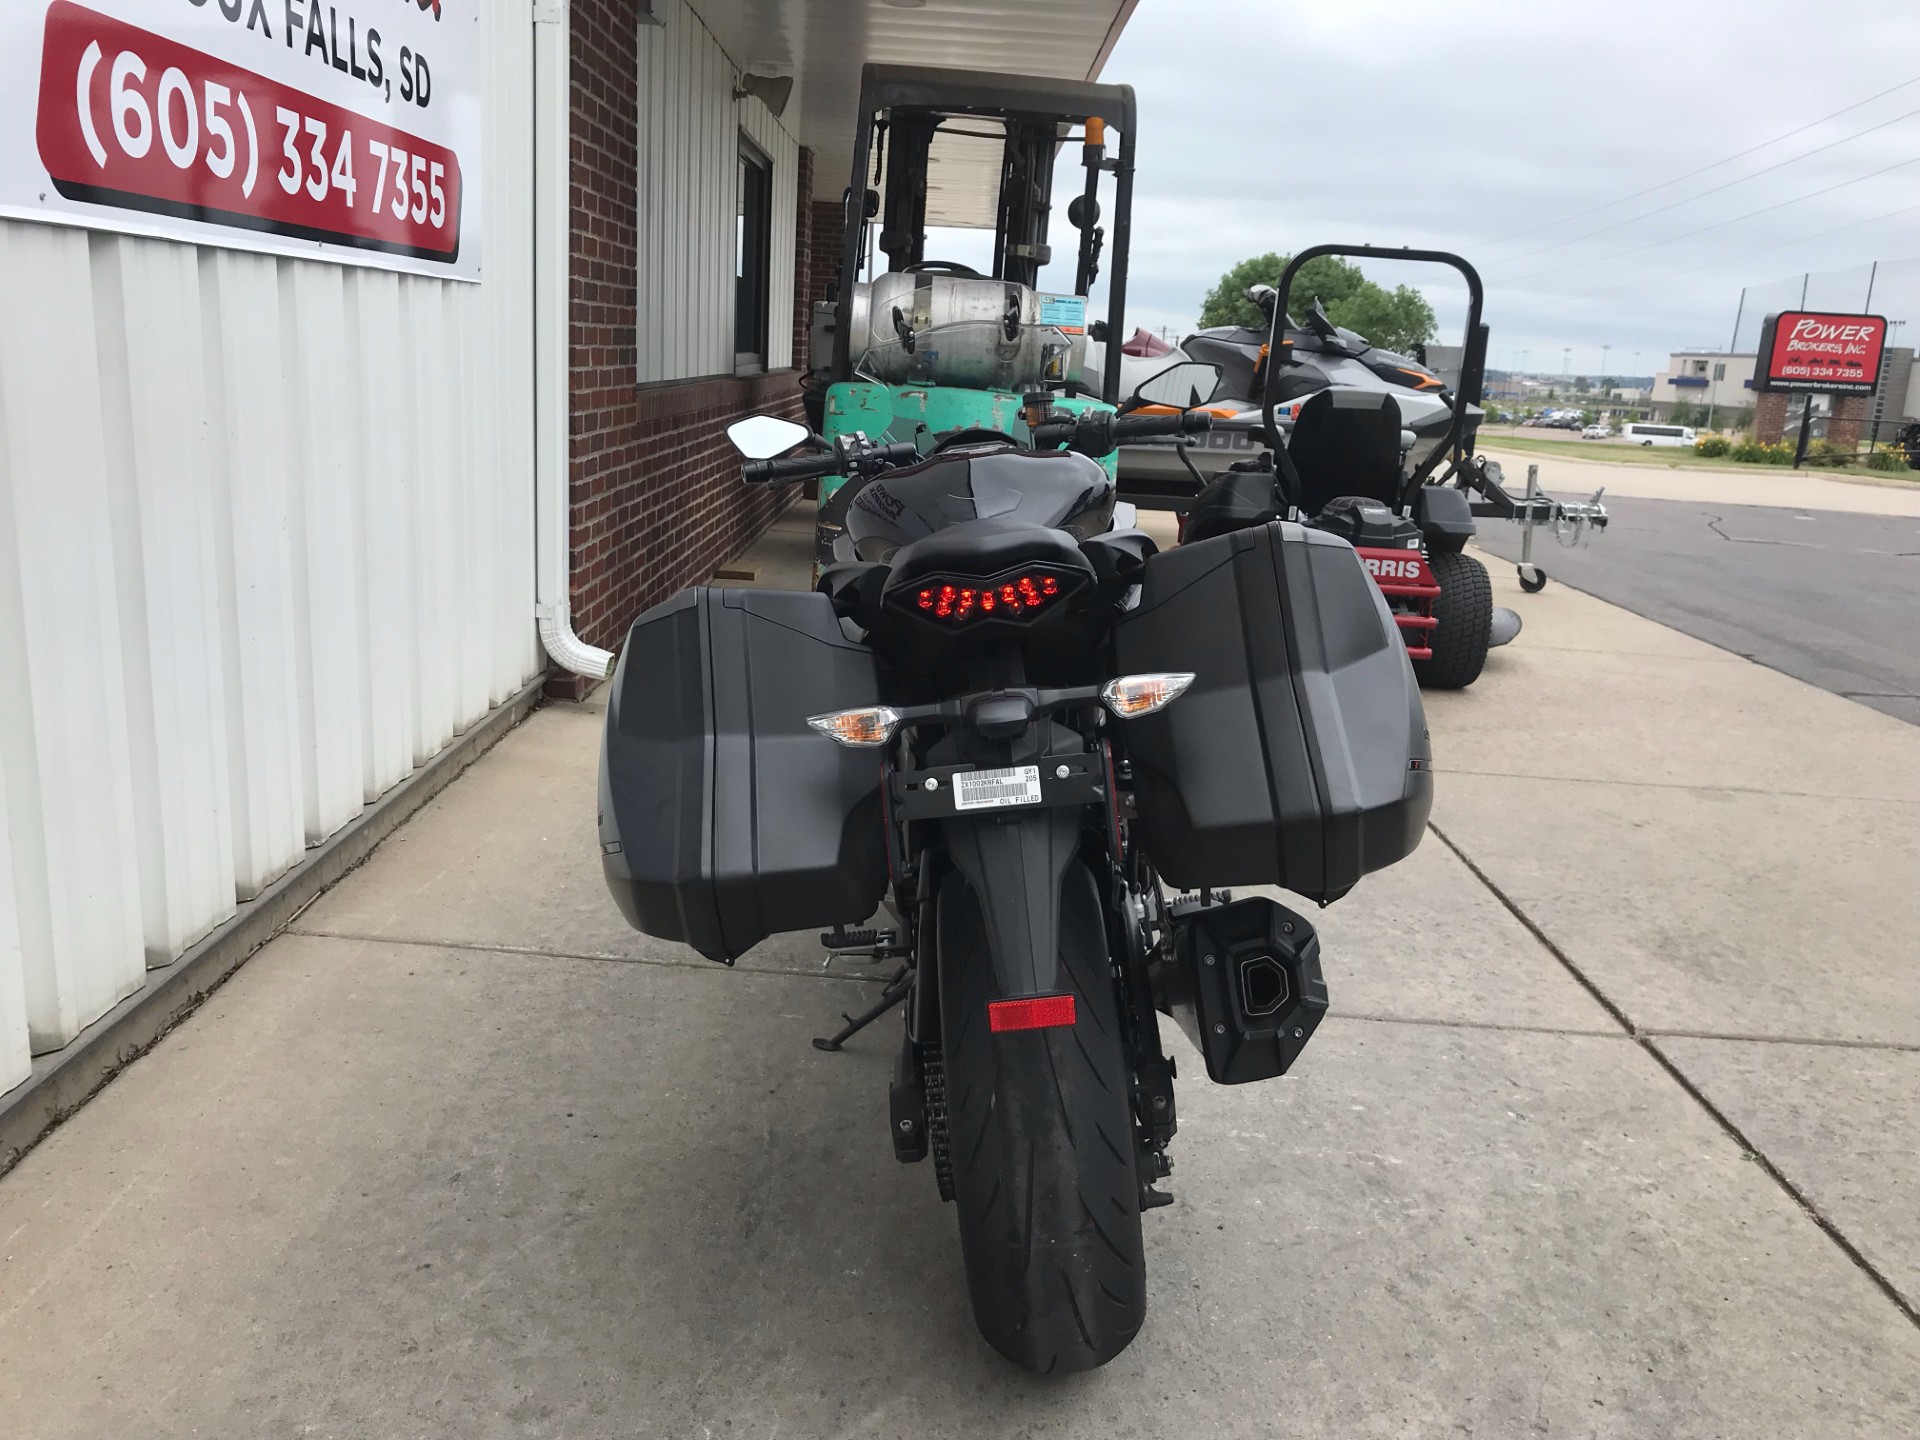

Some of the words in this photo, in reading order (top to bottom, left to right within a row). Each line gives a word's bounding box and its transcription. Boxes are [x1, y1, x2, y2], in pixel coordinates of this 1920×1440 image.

[285, 0, 391, 103] FALLS,
[399, 45, 431, 108] SD
[76, 39, 259, 199] (605)
[276, 106, 357, 207] 334
[369, 140, 446, 229] 7355
[1790, 318, 1875, 341] POWER
[1782, 365, 1810, 376] (605)
[1812, 367, 1833, 377] 334
[1836, 368, 1864, 378] 7355
[1015, 795, 1039, 803] FILLED
